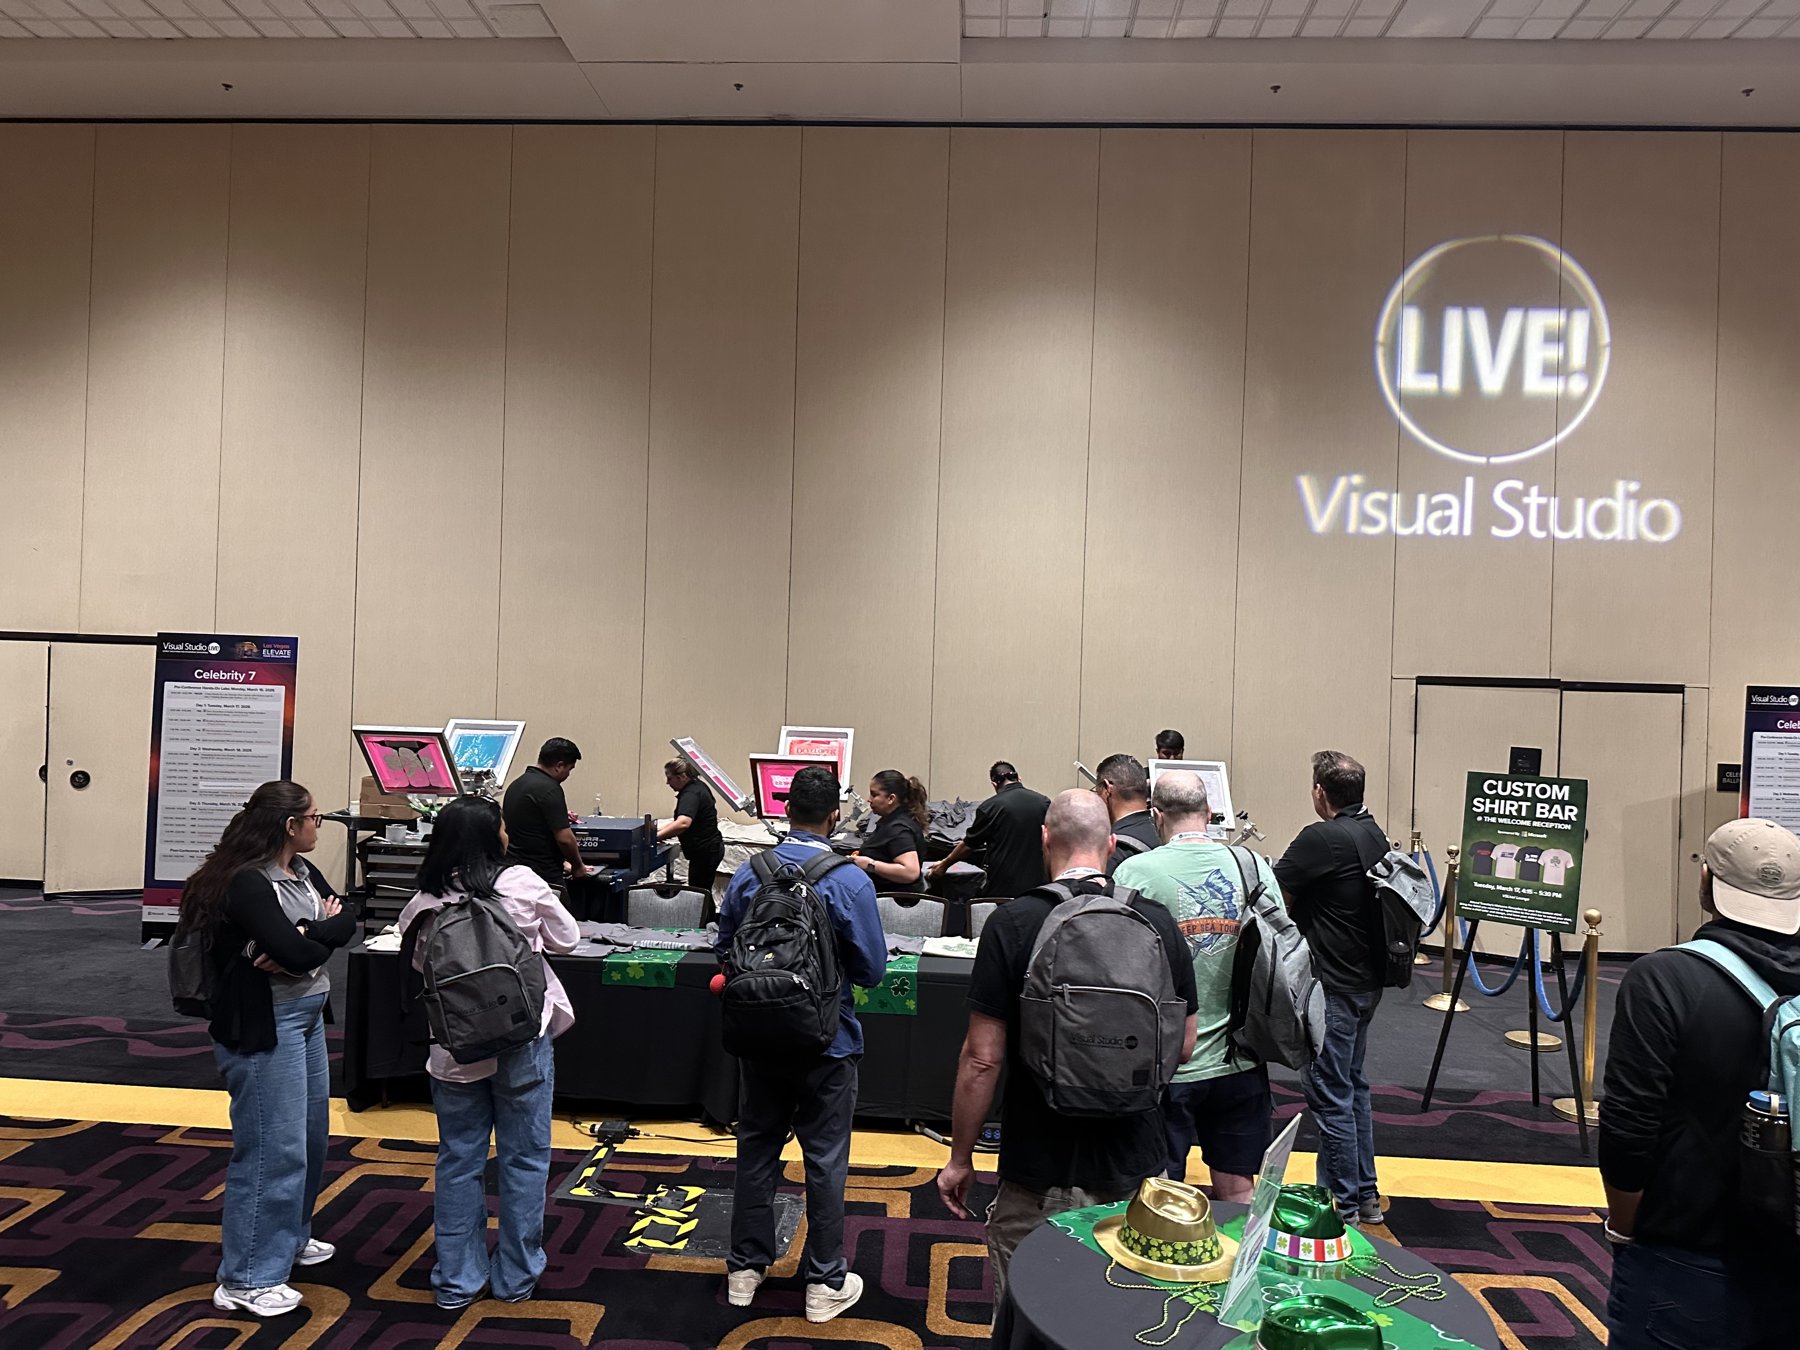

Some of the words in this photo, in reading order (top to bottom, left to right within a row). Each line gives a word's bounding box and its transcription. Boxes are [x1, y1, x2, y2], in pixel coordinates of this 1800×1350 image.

[1397, 305, 1590, 397] LIVE!
[1298, 474, 1474, 537] Visual
[1490, 479, 1682, 542] Studio
[162, 642, 183, 650] Visual
[184, 642, 207, 651] Studio
[194, 669, 246, 682] Celebrity
[248, 671, 256, 680] 7
[1751, 694, 1769, 702] Visual
[1769, 695, 1788, 703] Studio
[1483, 779, 1570, 801] CUSTOM
[1472, 797, 1531, 817] SHIRT
[1535, 802, 1578, 821] BAR
[1497, 818, 1531, 827] WELCOME
[1532, 820, 1571, 830] RECEPTION
[1473, 881, 1496, 890] Tuesday,
[1552, 891, 1562, 899] PM
[1181, 925, 1197, 934] EEP
[1200, 923, 1216, 932] SEA
[1220, 924, 1239, 934] TOUR
